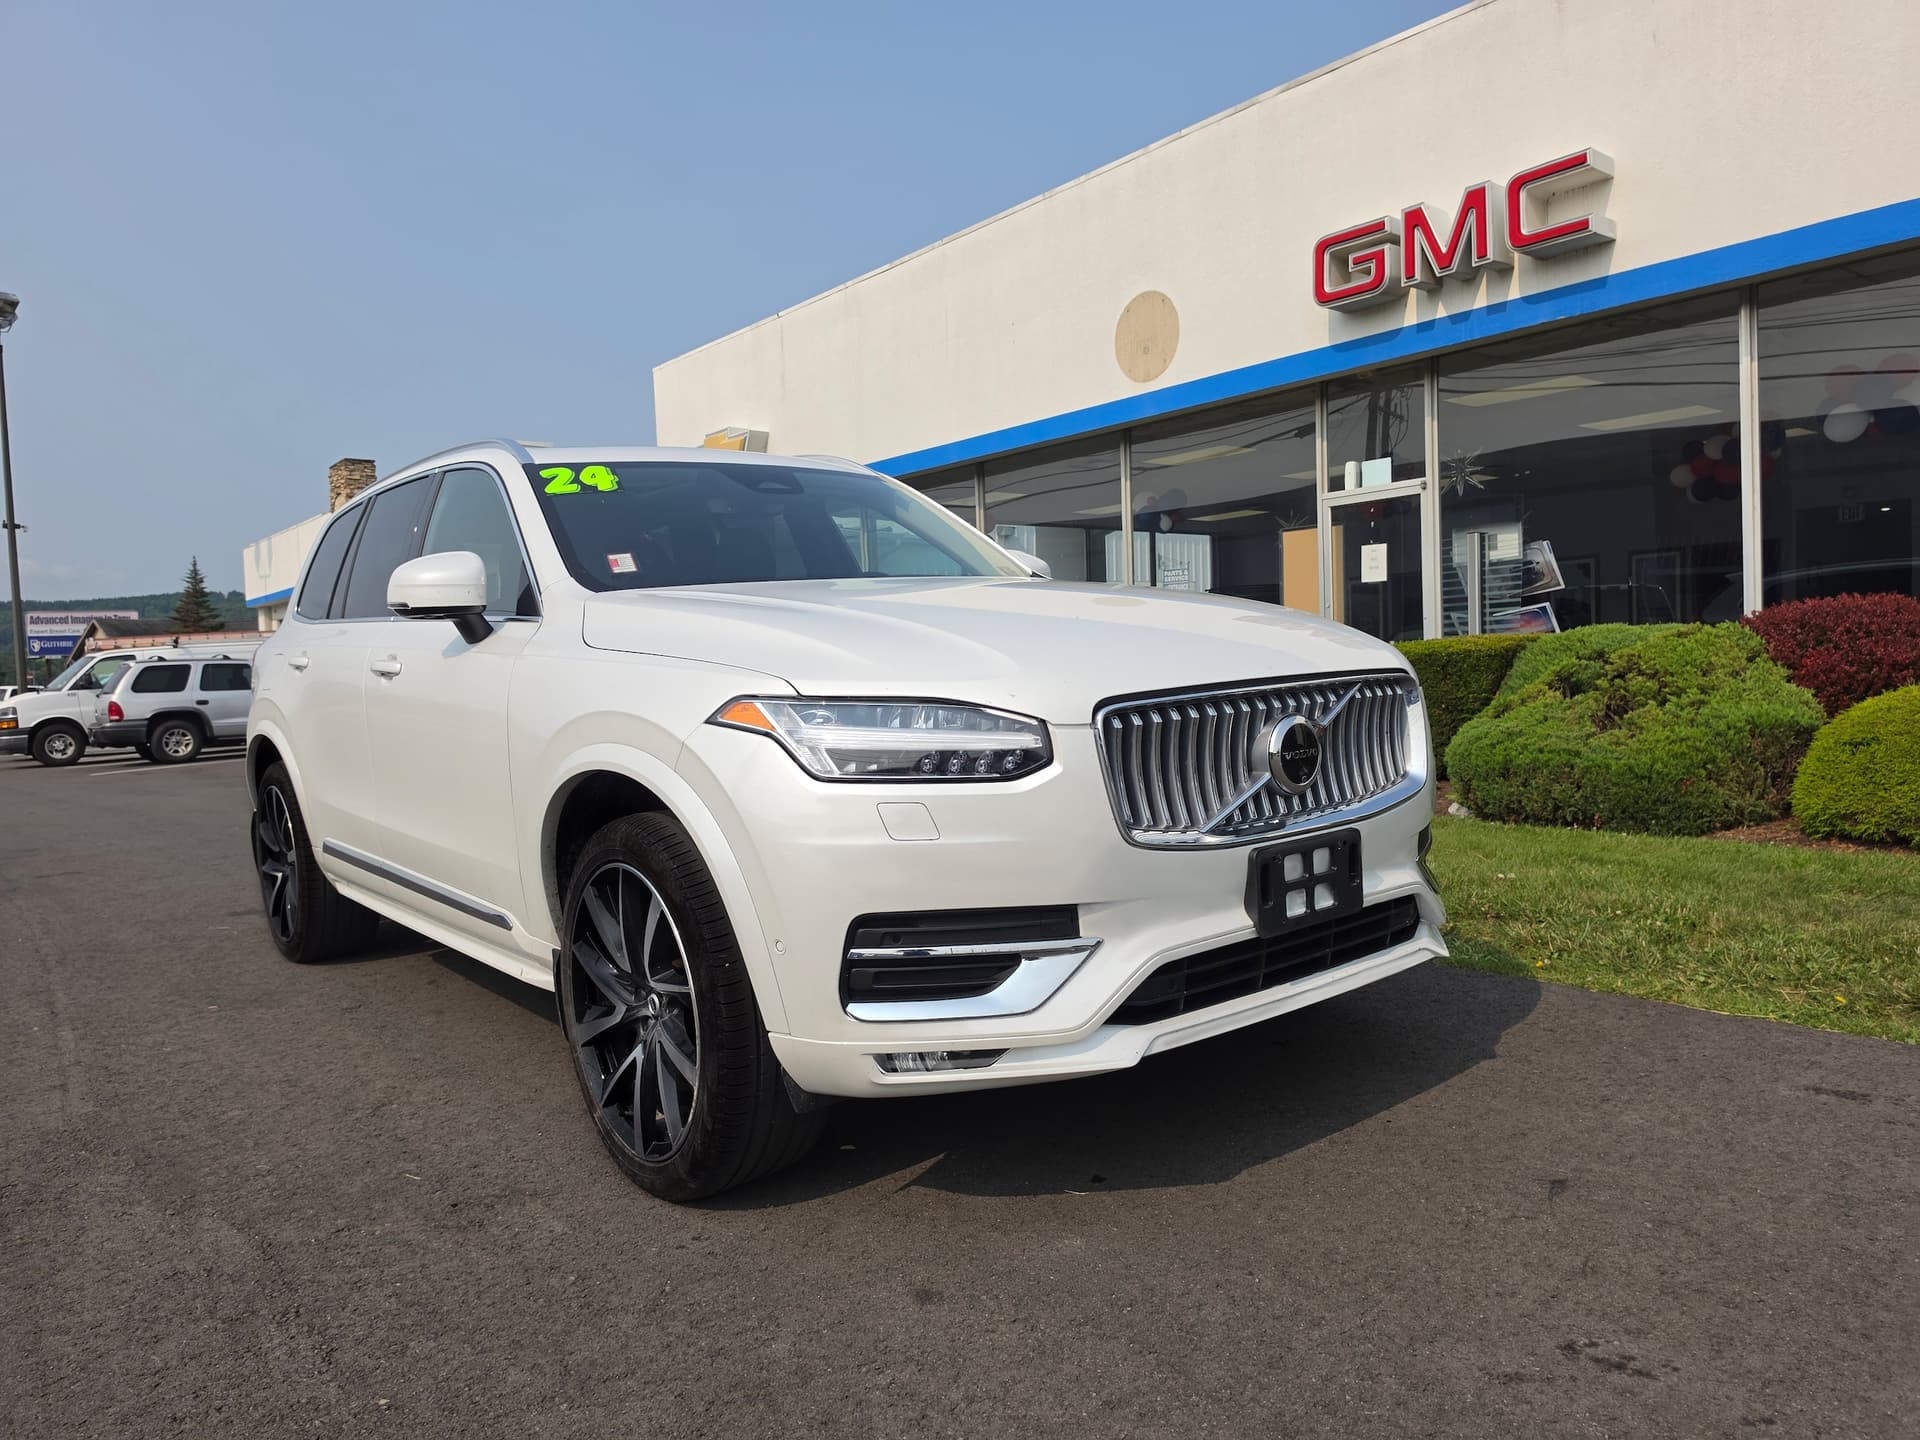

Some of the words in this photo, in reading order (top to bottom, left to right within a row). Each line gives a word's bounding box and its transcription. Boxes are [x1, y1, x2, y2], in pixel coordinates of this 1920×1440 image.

[1313, 147, 1616, 312] GMC
[539, 465, 619, 495] 24
[29, 615, 69, 625] Advanced
[70, 614, 102, 625] Imag
[41, 640, 74, 648] GUTHRIE
